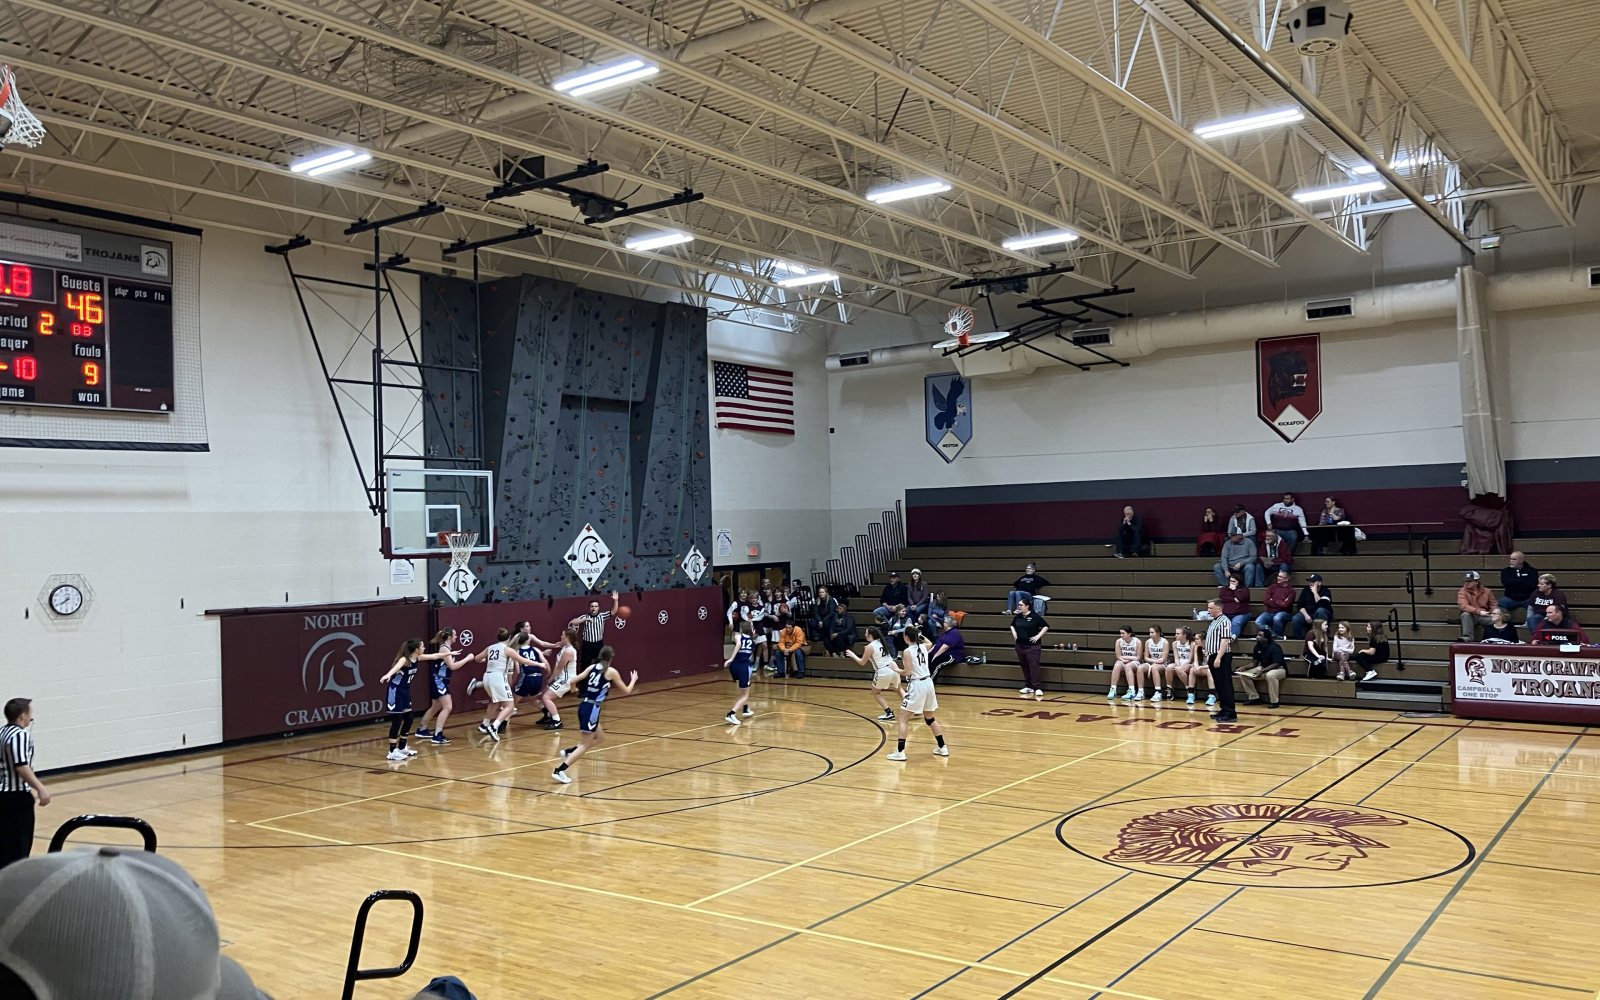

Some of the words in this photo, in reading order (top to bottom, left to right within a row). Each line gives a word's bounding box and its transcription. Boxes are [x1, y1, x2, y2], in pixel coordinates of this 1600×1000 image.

[84, 247, 140, 263] TROJANS
[61, 274, 101, 292] Guests
[135, 290, 147, 299] pts
[154, 291, 165, 301] fls
[66, 291, 103, 324] 46
[39, 311, 54, 335] 2
[74, 343, 101, 358] fouls
[15, 358, 36, 380] 10
[83, 362, 98, 386] 9
[0, 387, 25, 398] ame
[78, 392, 100, 403] won
[577, 567, 601, 575] TROJANS
[304, 612, 363, 630] NORTH
[741, 639, 753, 650] 12
[489, 650, 500, 661] 23
[523, 651, 536, 661] 34
[1491, 659, 1542, 674] NORTH
[587, 672, 601, 687] 24
[1512, 678, 1600, 699] TROJANS
[285, 700, 383, 726] CRAWFORD
[980, 707, 1302, 738] TROJANS
